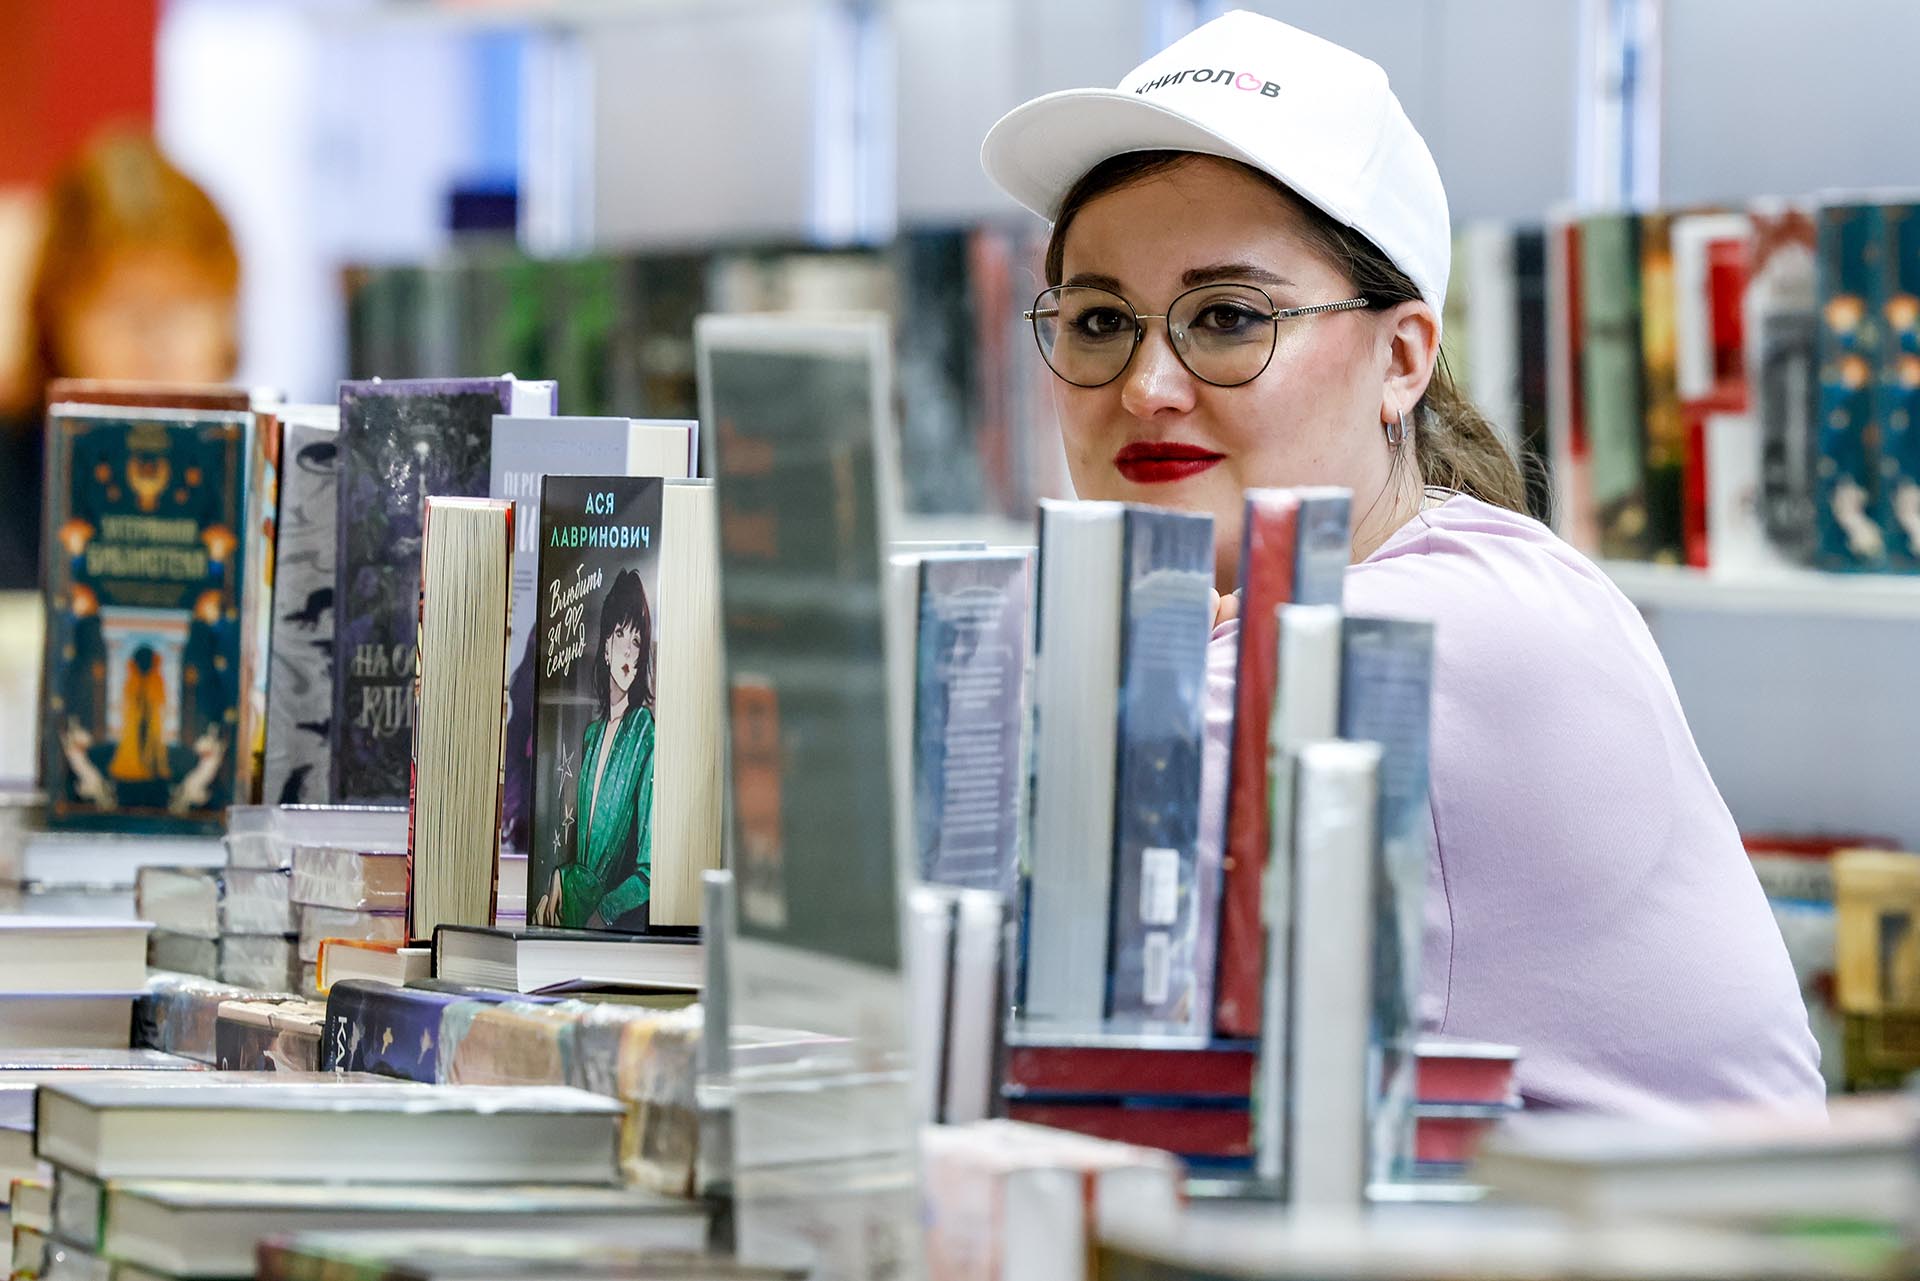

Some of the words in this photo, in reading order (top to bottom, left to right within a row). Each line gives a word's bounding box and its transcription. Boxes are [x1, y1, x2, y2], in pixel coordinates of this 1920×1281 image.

[585, 492, 615, 515] АСЯ
[550, 526, 650, 548] ЛАВРИНОВИЧ
[549, 563, 603, 618] Влюбить
[350, 644, 389, 676] НА
